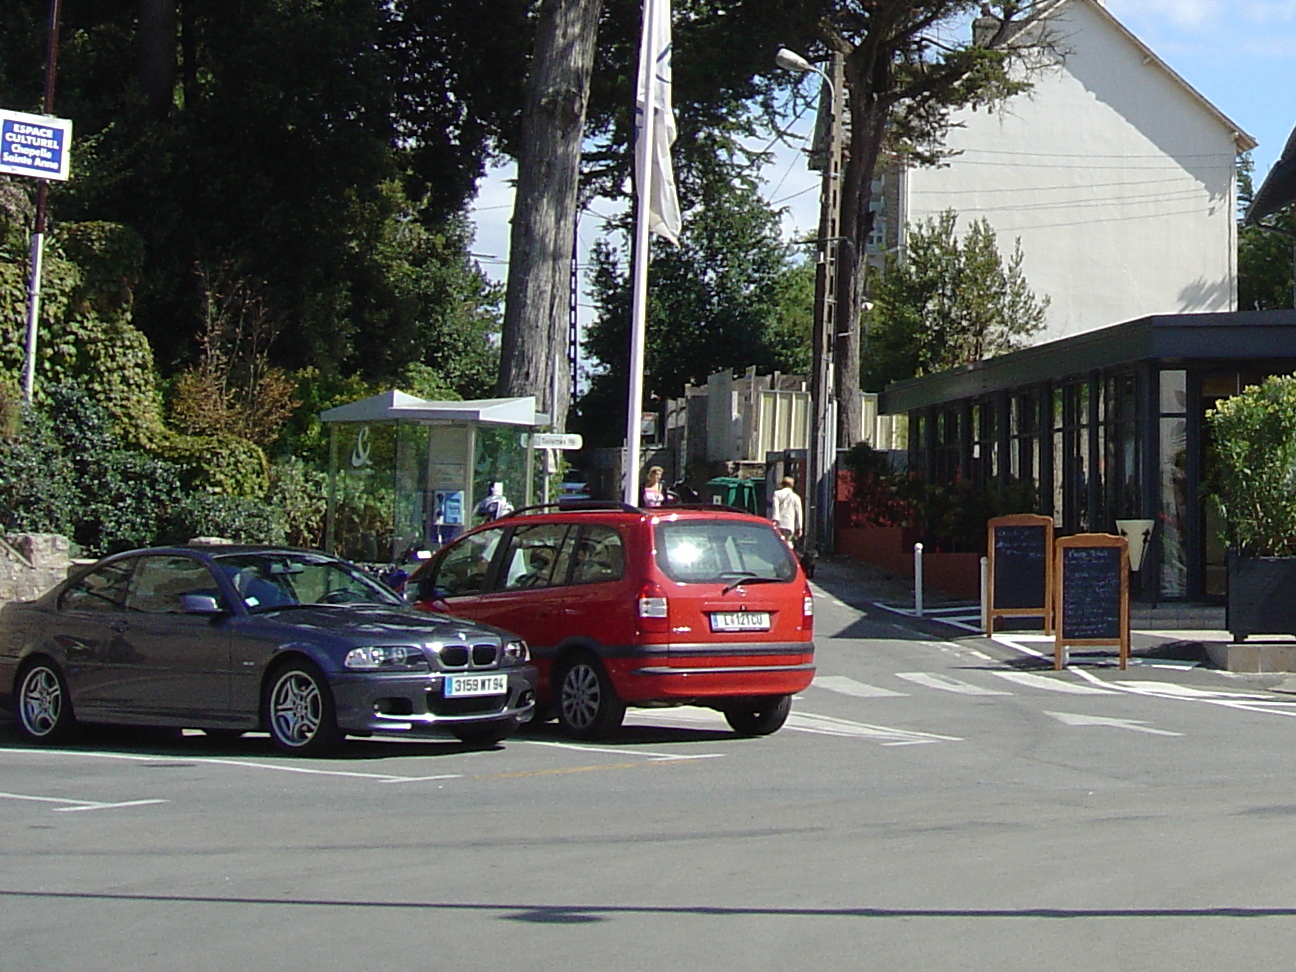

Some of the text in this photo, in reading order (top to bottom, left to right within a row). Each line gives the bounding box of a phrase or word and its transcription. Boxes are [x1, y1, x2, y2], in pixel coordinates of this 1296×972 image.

[13, 123, 53, 138] ESPACE
[5, 132, 59, 149] CULTUREL
[11, 143, 52, 159] Chapelle
[454, 679, 479, 692] 3159
